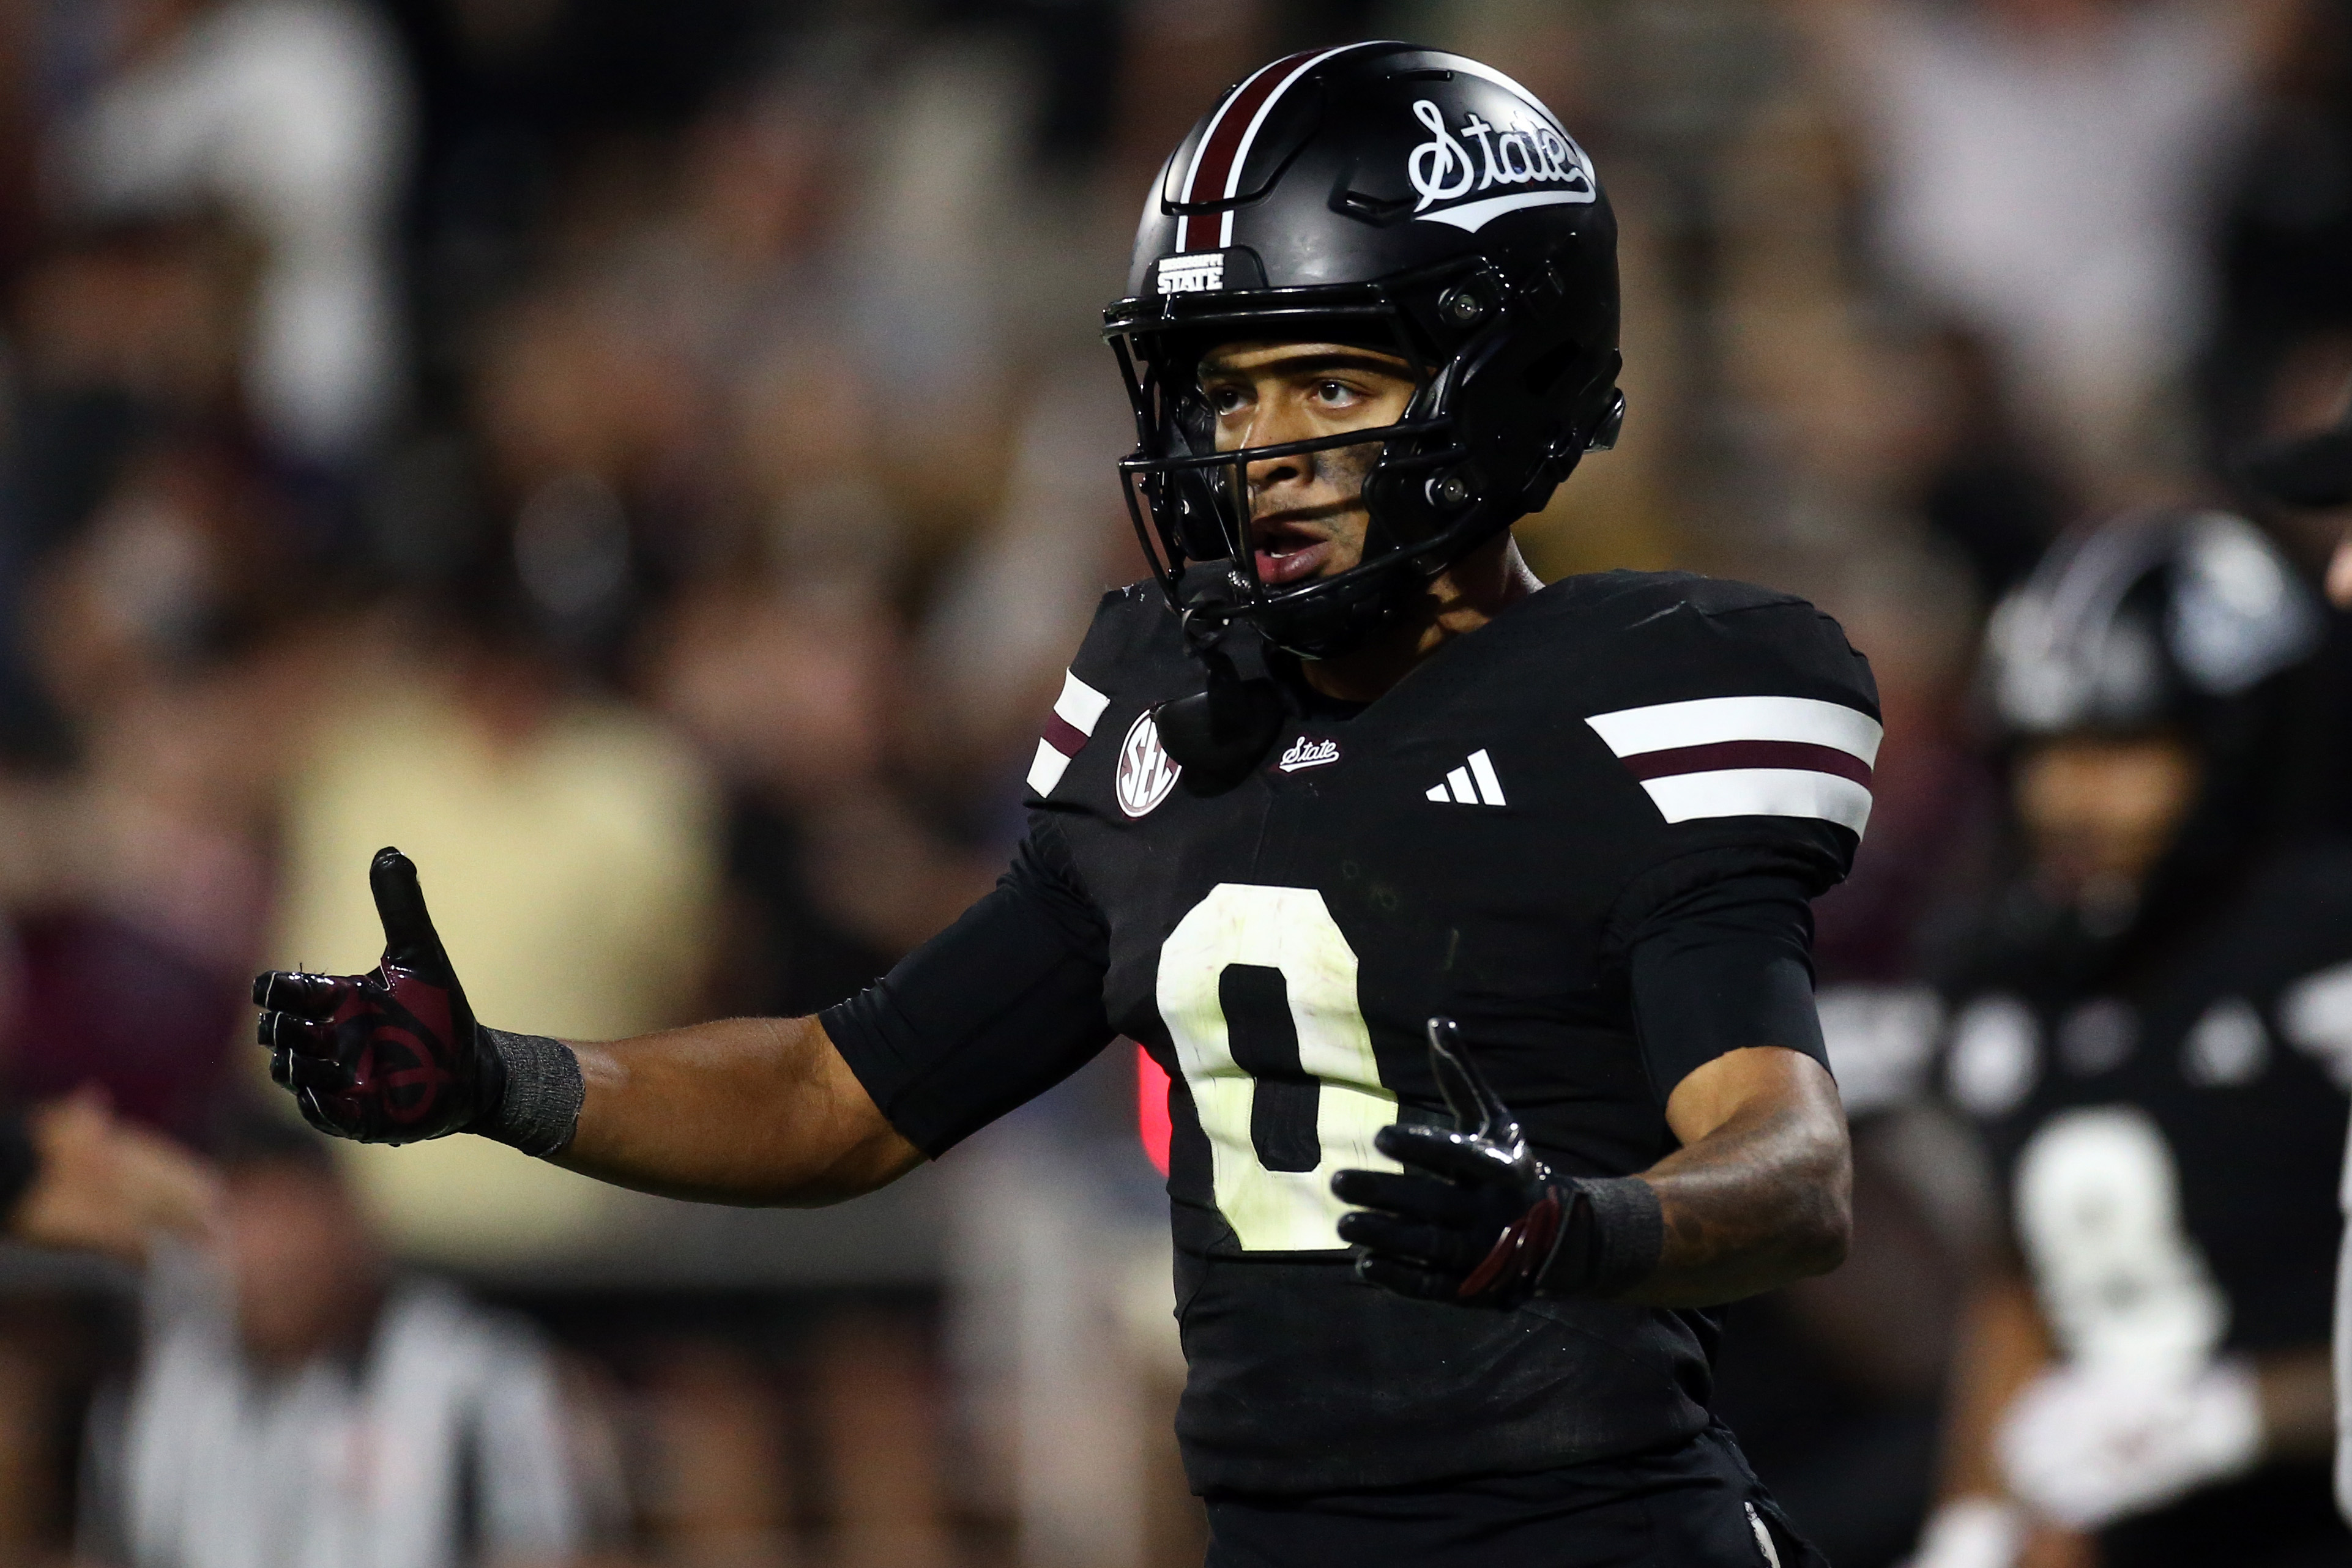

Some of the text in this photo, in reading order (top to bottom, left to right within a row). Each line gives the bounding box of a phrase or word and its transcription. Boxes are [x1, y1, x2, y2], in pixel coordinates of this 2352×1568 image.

[1408, 99, 1596, 234] State
[1158, 267, 1223, 294] STATE
[1279, 736, 1340, 772] State
[1156, 883, 1405, 1251] 0
